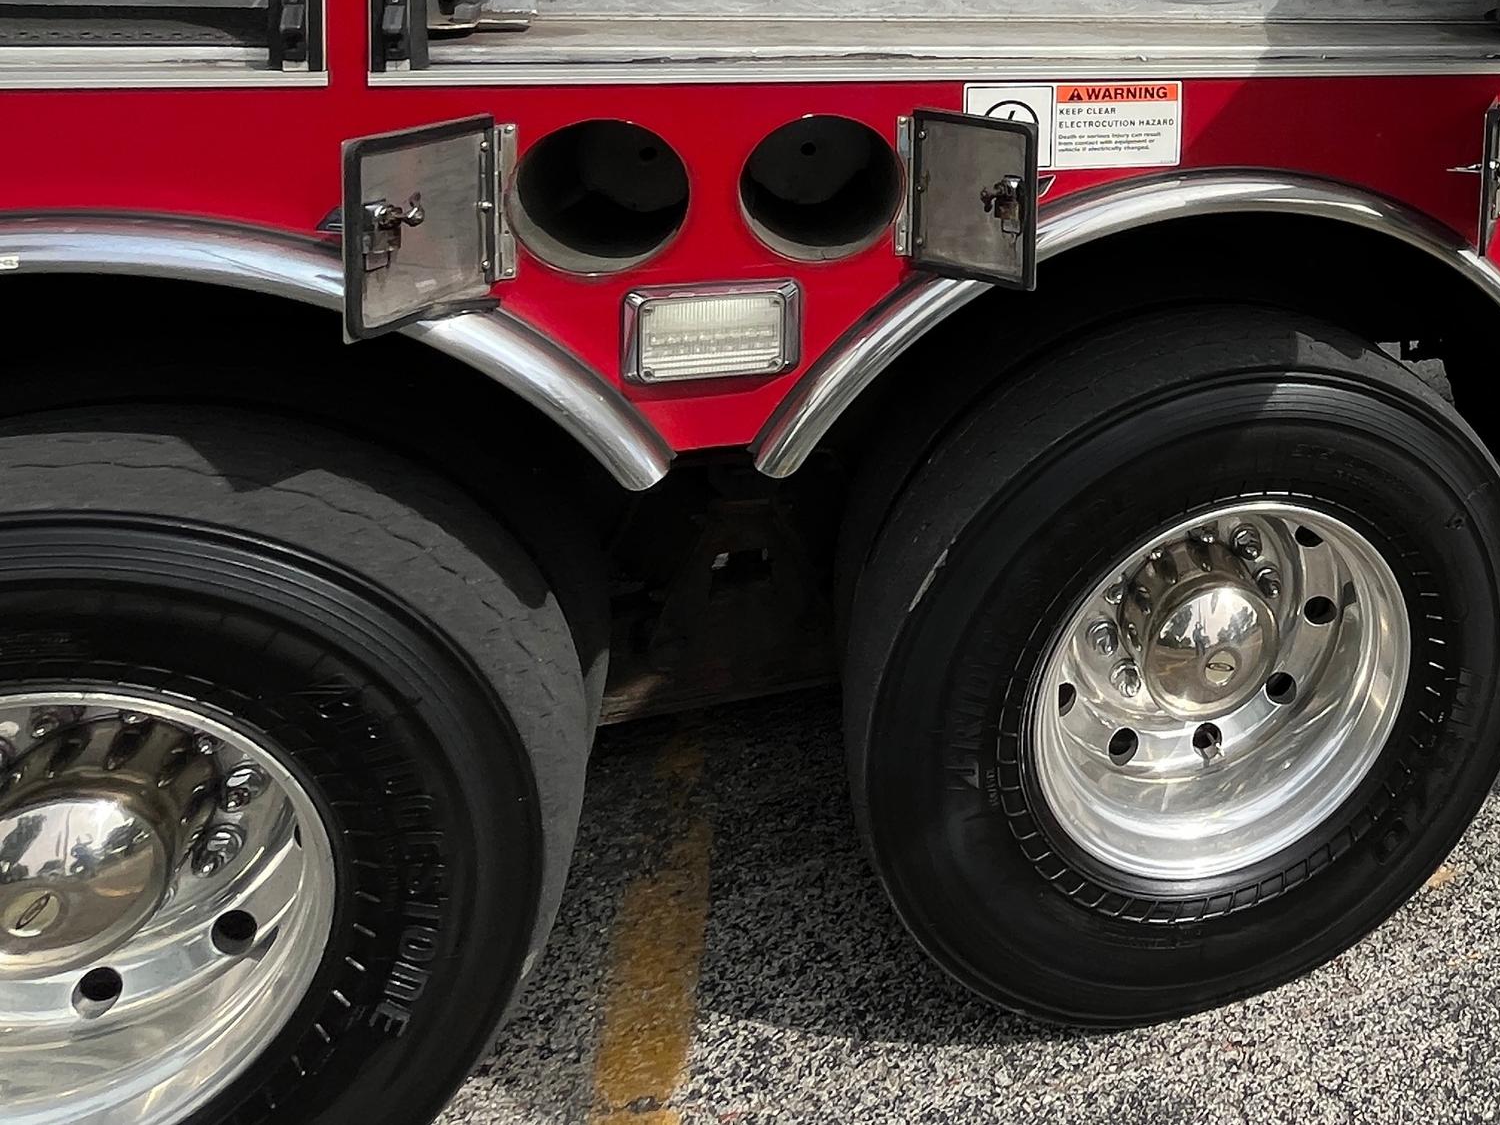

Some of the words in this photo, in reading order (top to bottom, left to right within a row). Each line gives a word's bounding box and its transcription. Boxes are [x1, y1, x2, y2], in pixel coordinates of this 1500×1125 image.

[1086, 86, 1168, 101] WARNING
[1058, 107, 1084, 116] KEEP
[1086, 107, 1117, 115] CLEAR
[1058, 119, 1136, 129] ELECTROCUTION
[1138, 118, 1175, 127] HAZARD
